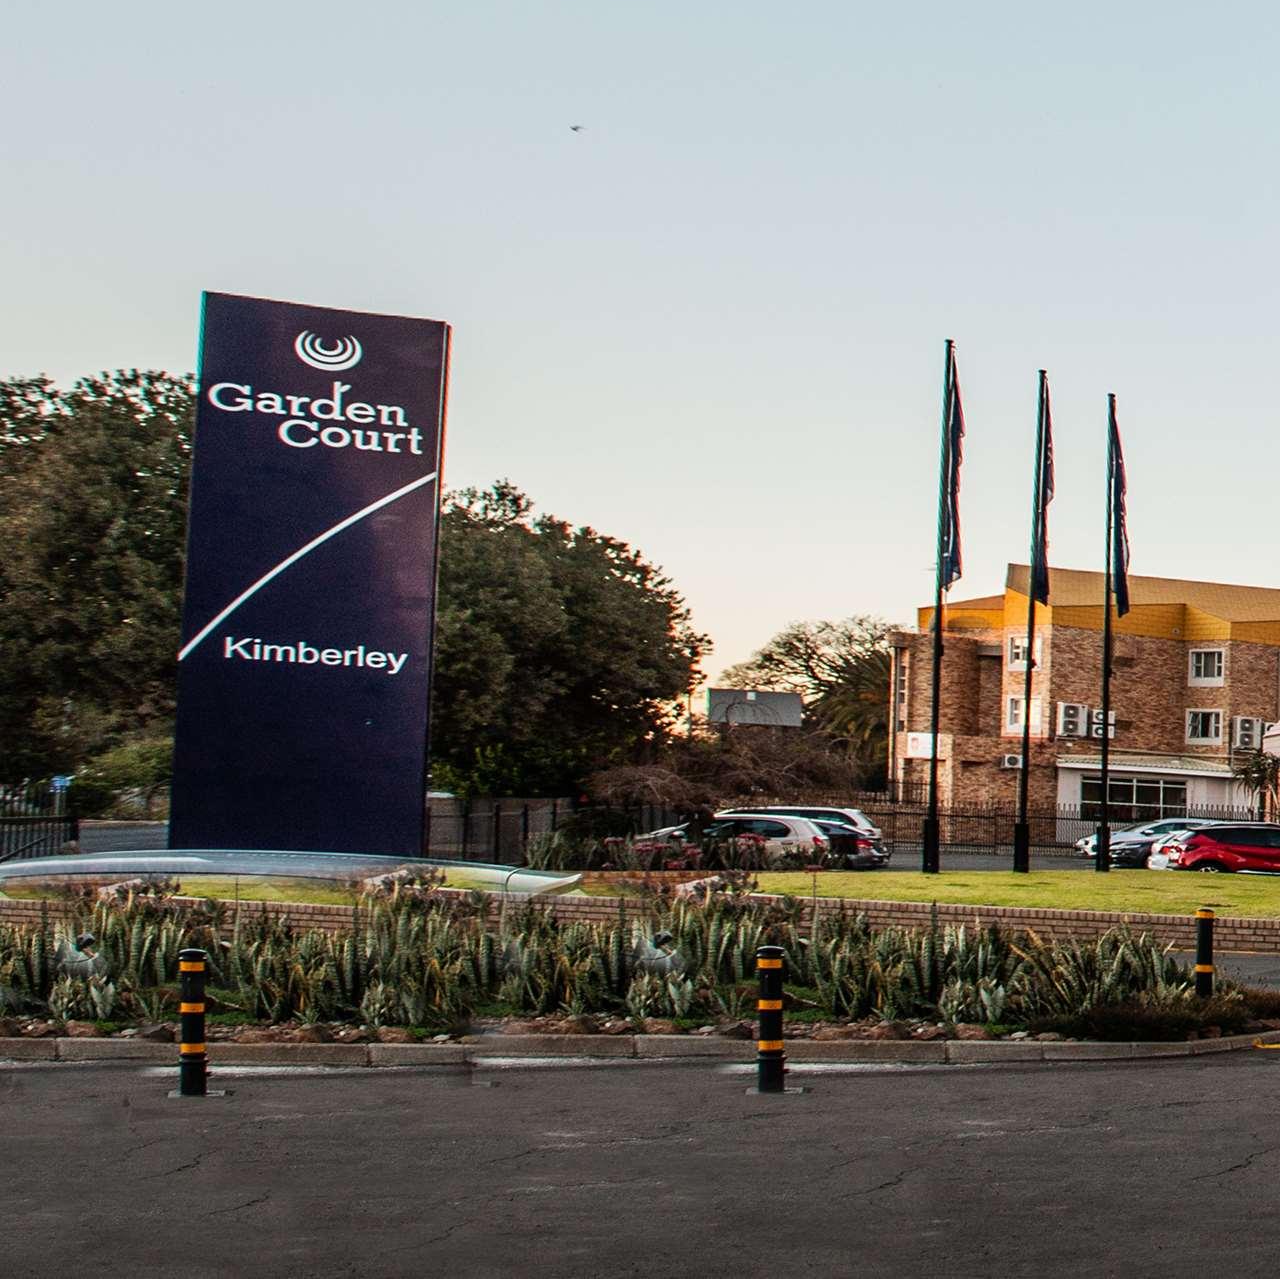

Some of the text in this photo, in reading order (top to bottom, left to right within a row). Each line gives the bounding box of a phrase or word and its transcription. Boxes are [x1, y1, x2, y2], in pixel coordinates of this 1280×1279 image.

[208, 381, 409, 427] Garden
[278, 419, 423, 455] Court
[224, 636, 408, 675] Kimberley
